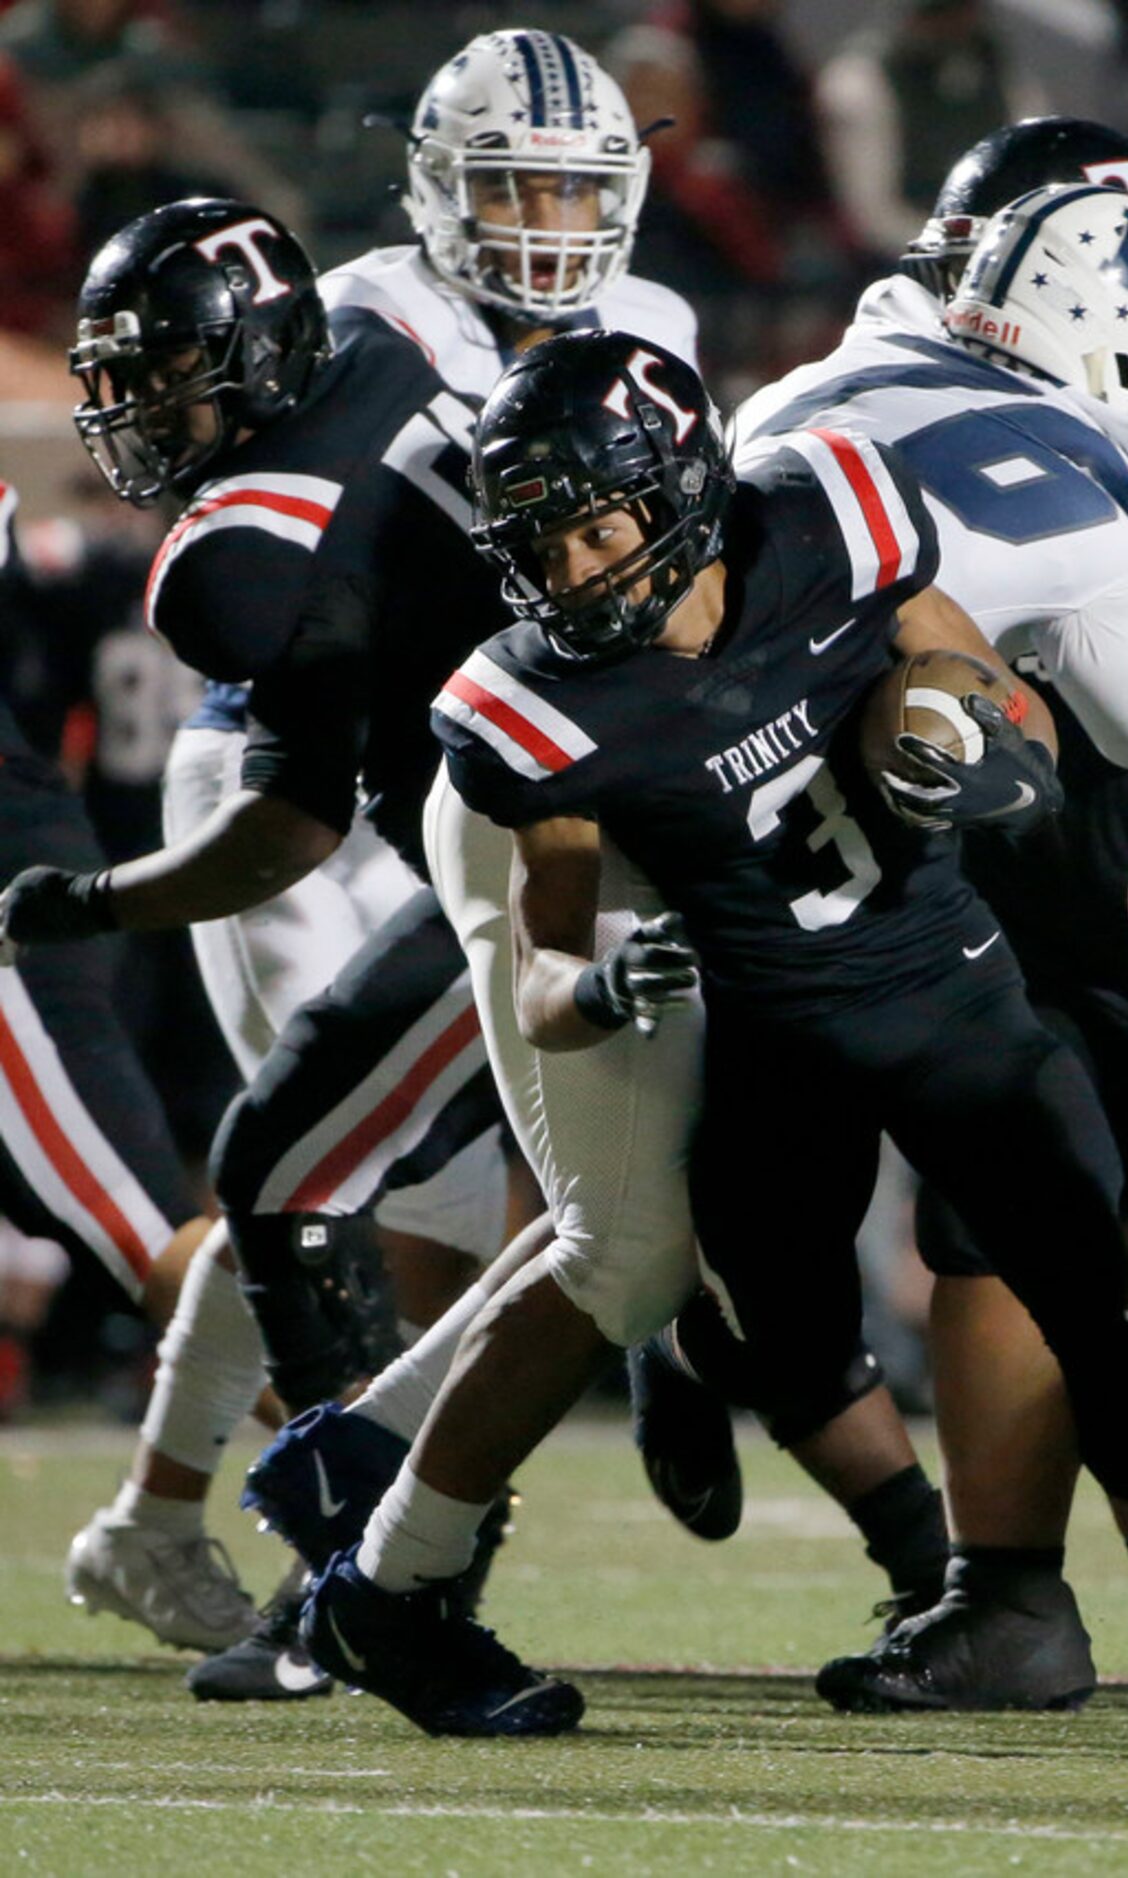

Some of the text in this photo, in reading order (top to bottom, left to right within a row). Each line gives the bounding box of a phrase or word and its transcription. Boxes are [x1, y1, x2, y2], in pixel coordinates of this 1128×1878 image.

[193, 217, 293, 306] T
[602, 349, 699, 447] T
[705, 699, 819, 794] TRINITY
[747, 754, 882, 932] 3
